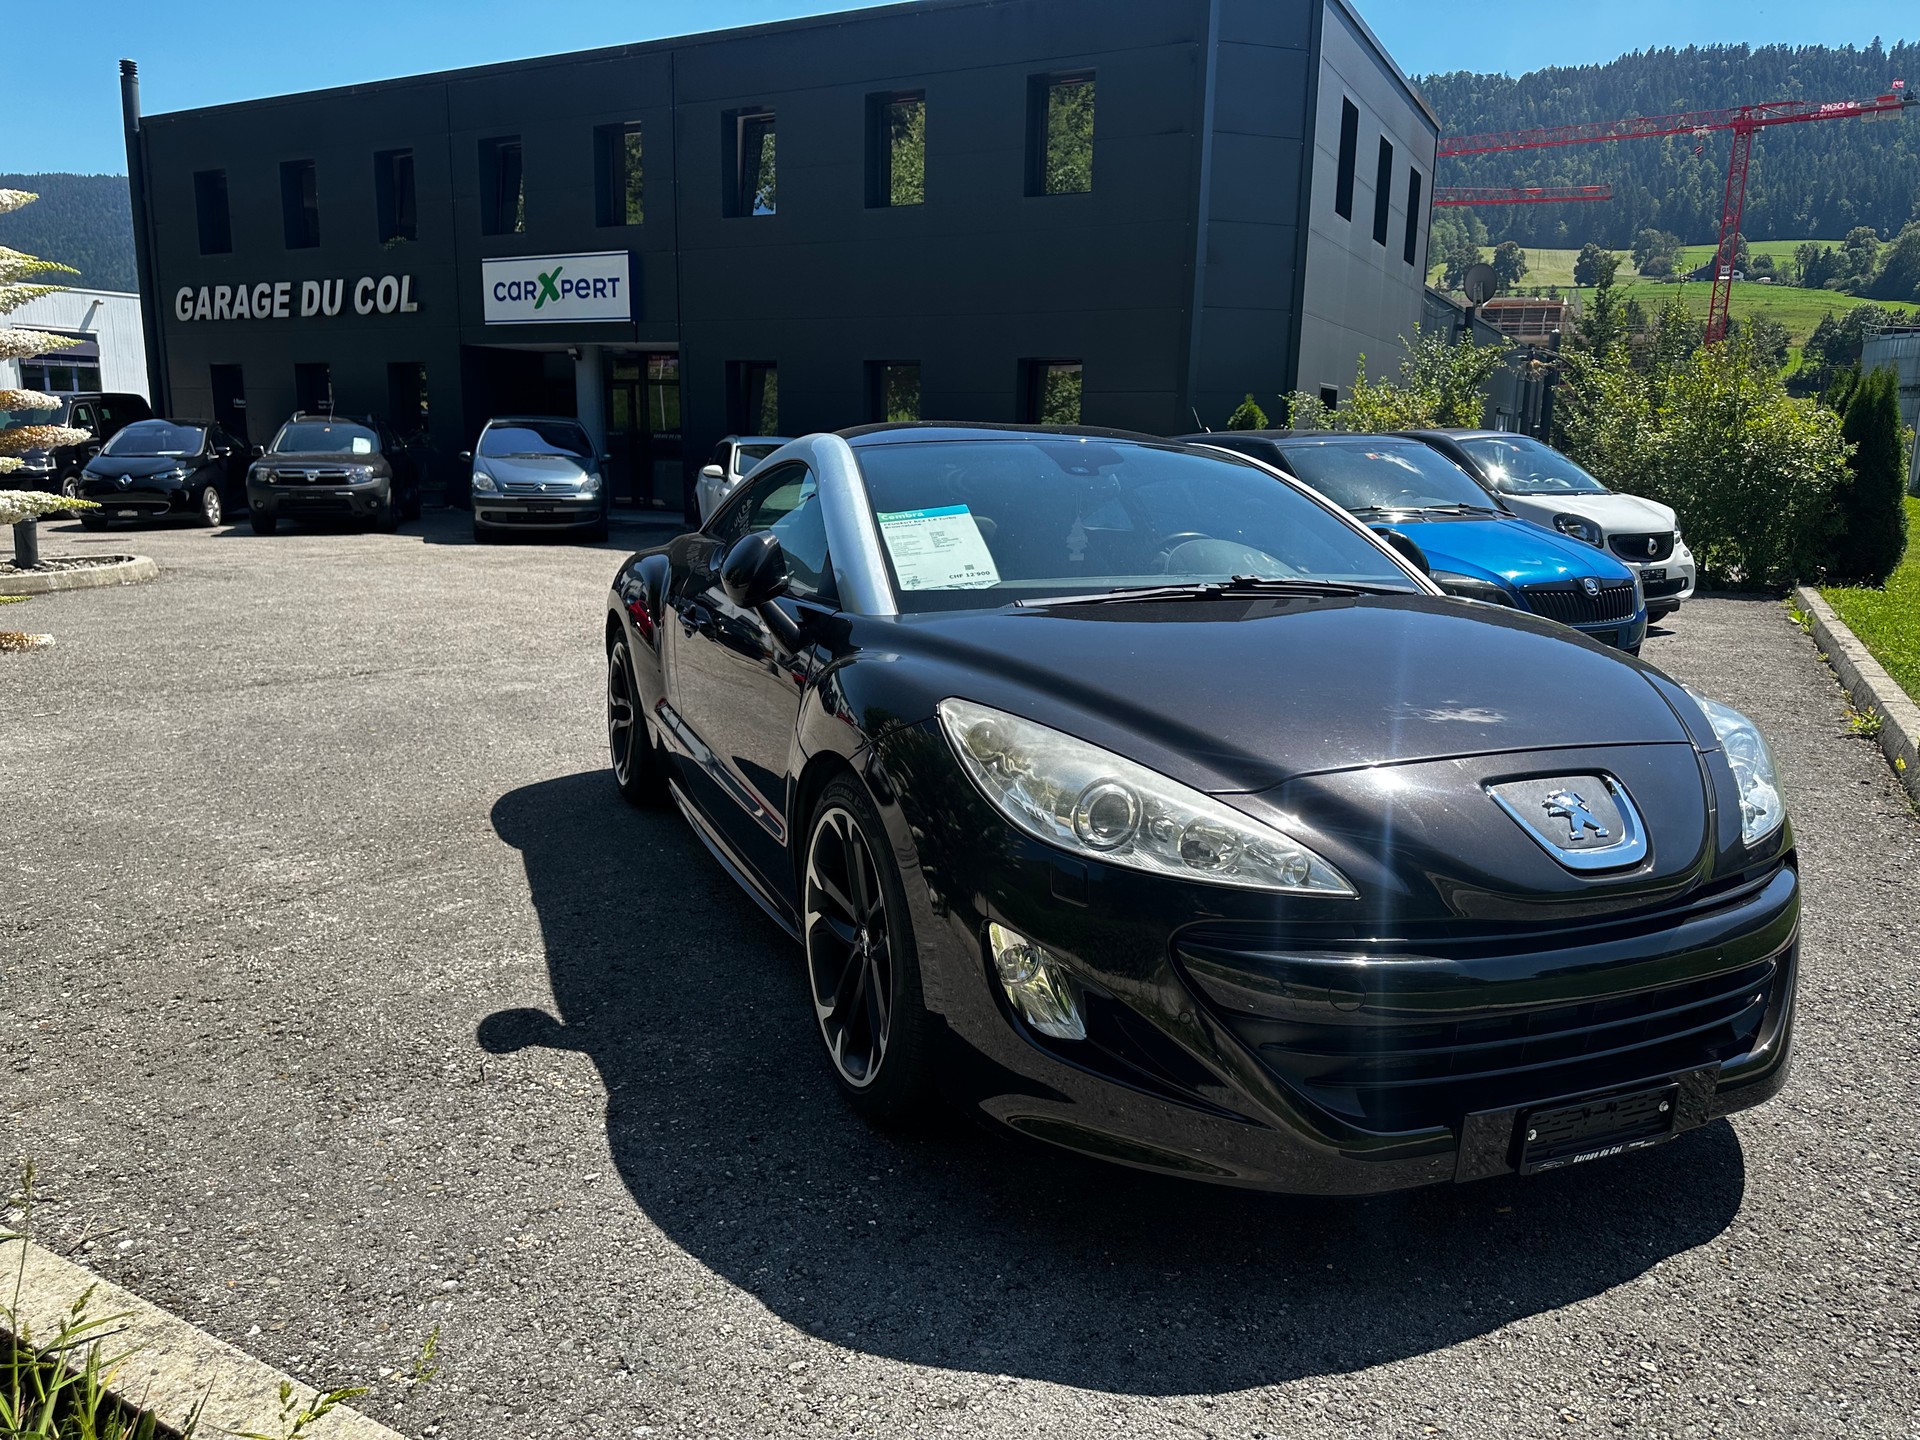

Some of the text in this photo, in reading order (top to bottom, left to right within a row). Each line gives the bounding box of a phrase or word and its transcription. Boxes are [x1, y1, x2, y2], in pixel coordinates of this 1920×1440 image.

[174, 274, 419, 322] GARAGE DU COL
[881, 512, 924, 520] Cembra
[1573, 1146, 1623, 1163] Garage du Col
